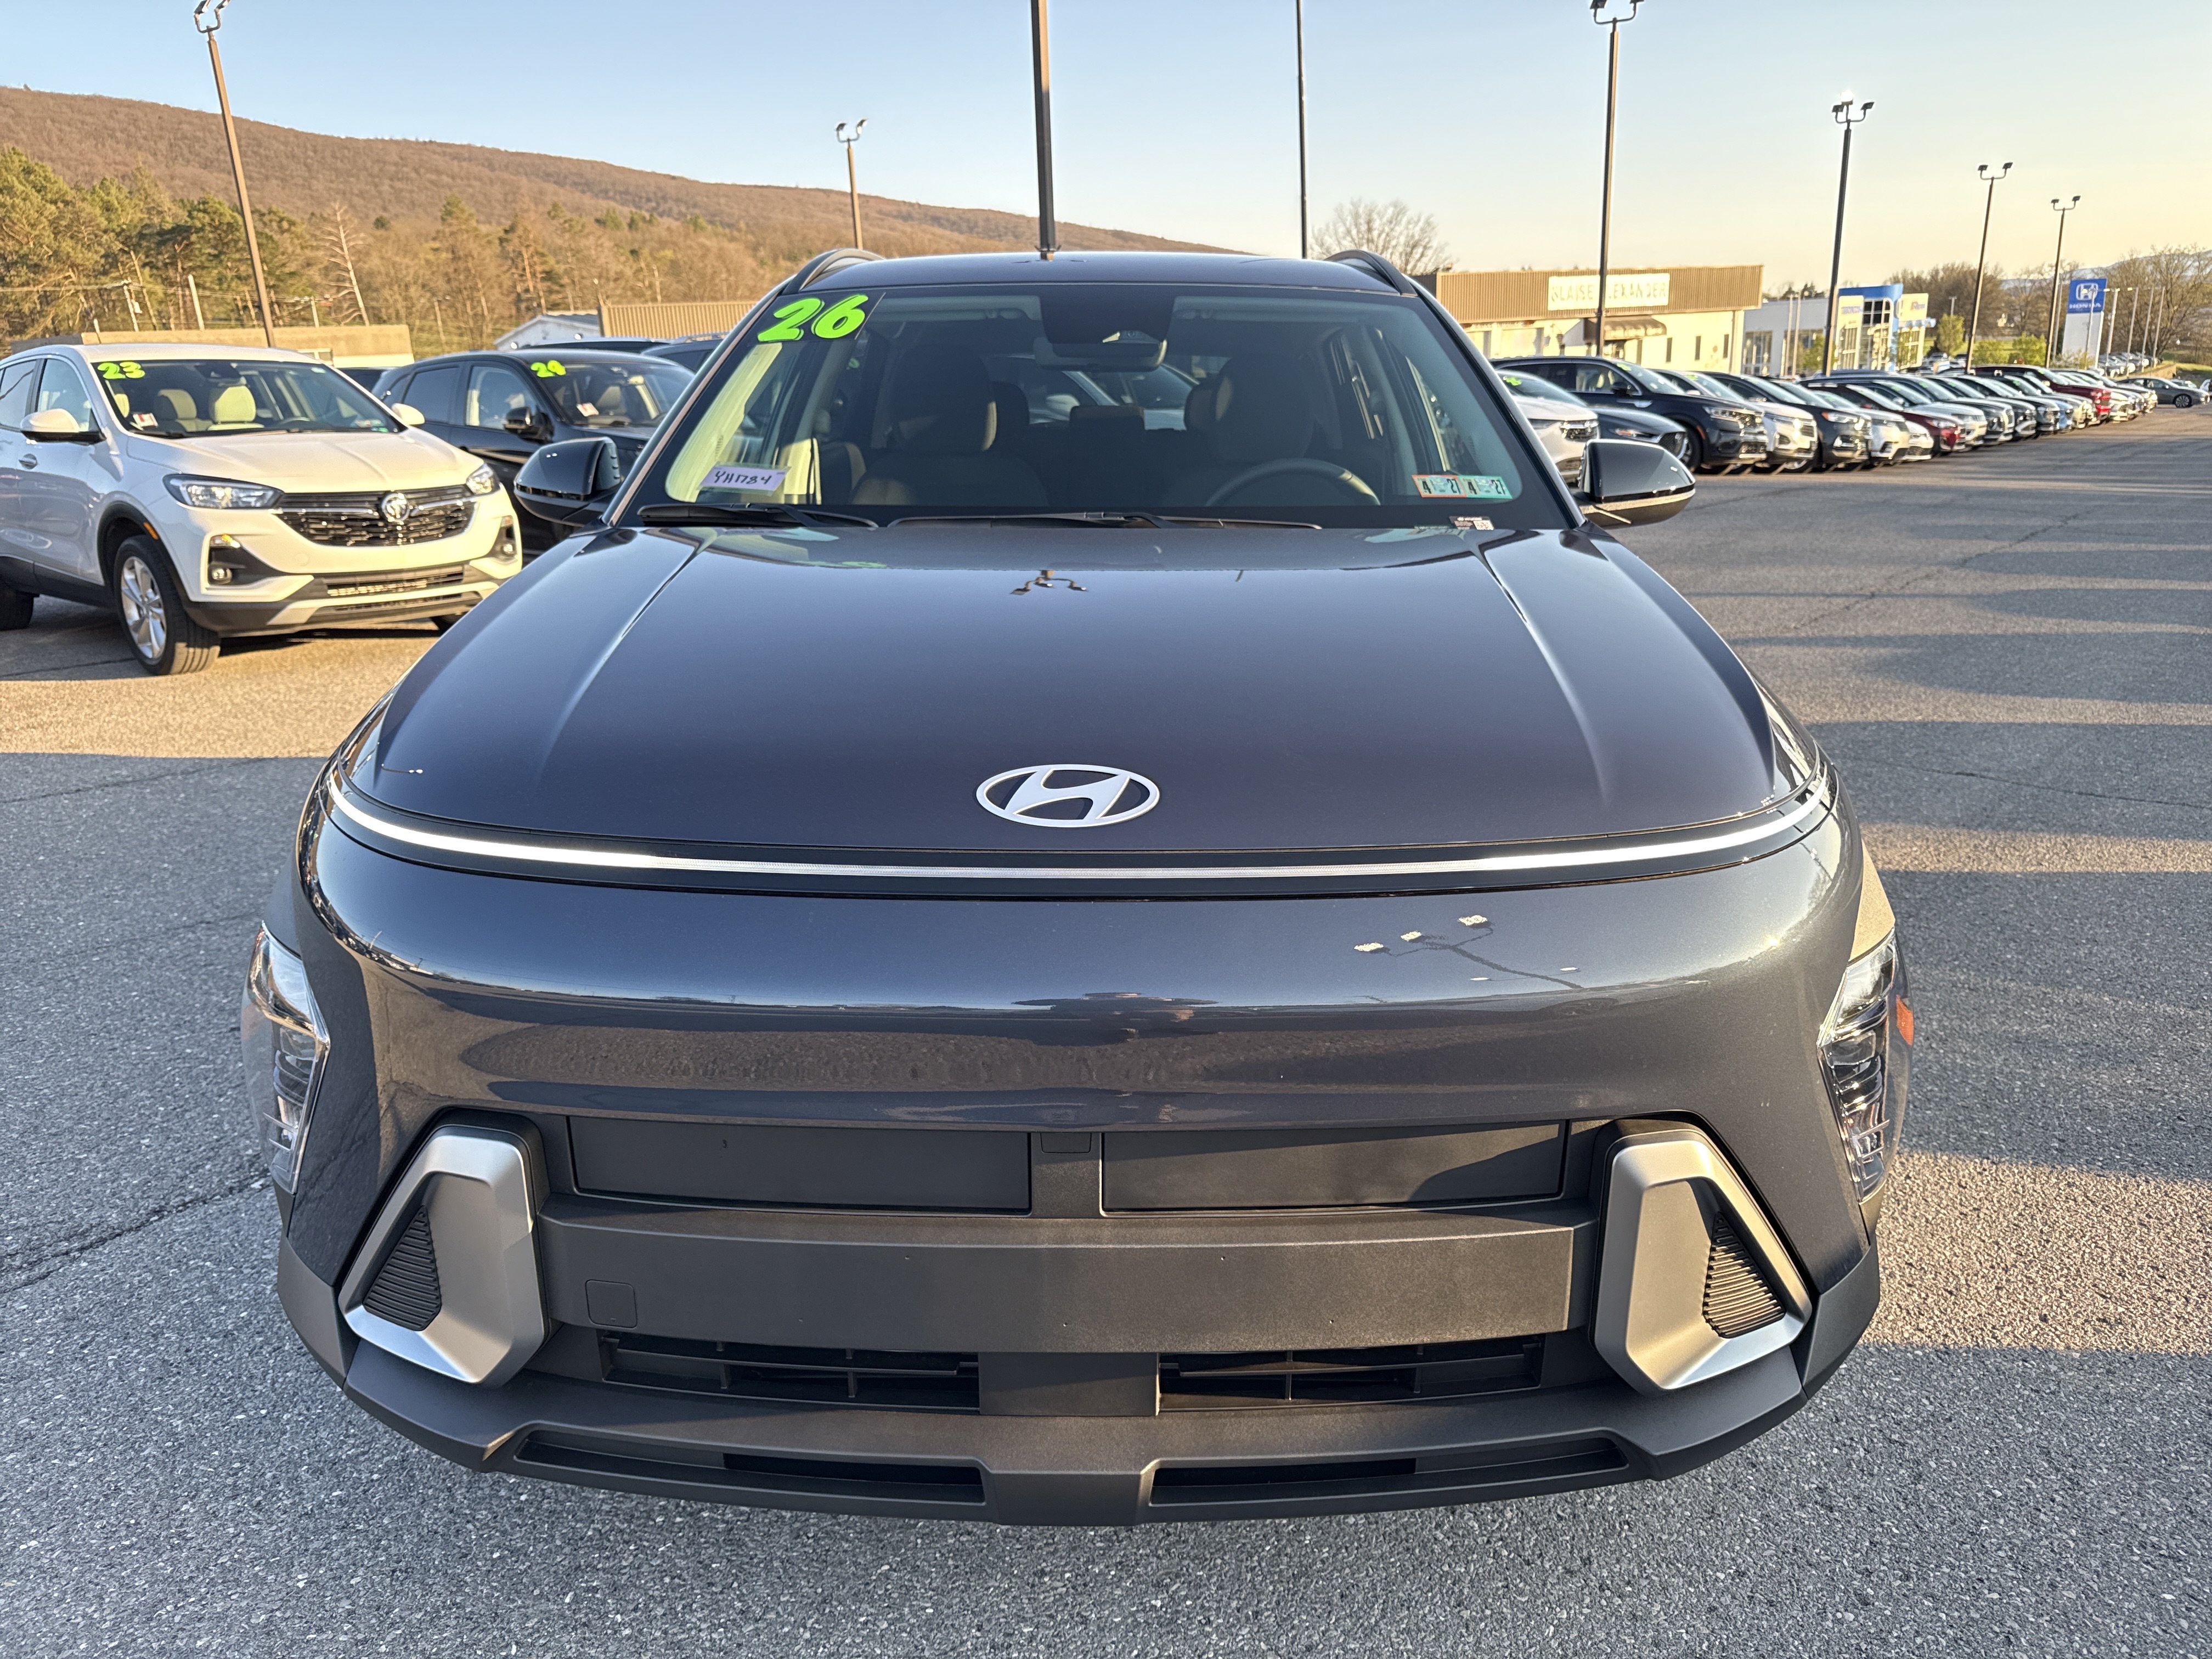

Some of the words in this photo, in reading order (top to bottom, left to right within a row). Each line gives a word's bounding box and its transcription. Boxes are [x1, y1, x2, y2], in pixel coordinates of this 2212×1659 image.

[1607, 281, 1667, 301] EXANDER
[757, 294, 868, 342] 26
[97, 361, 146, 380] 23
[714, 470, 772, 485] YH1784
[1422, 481, 1432, 494] 4
[1447, 478, 1462, 495] 27
[1468, 481, 1478, 495] 4
[1491, 479, 1506, 495] 27
